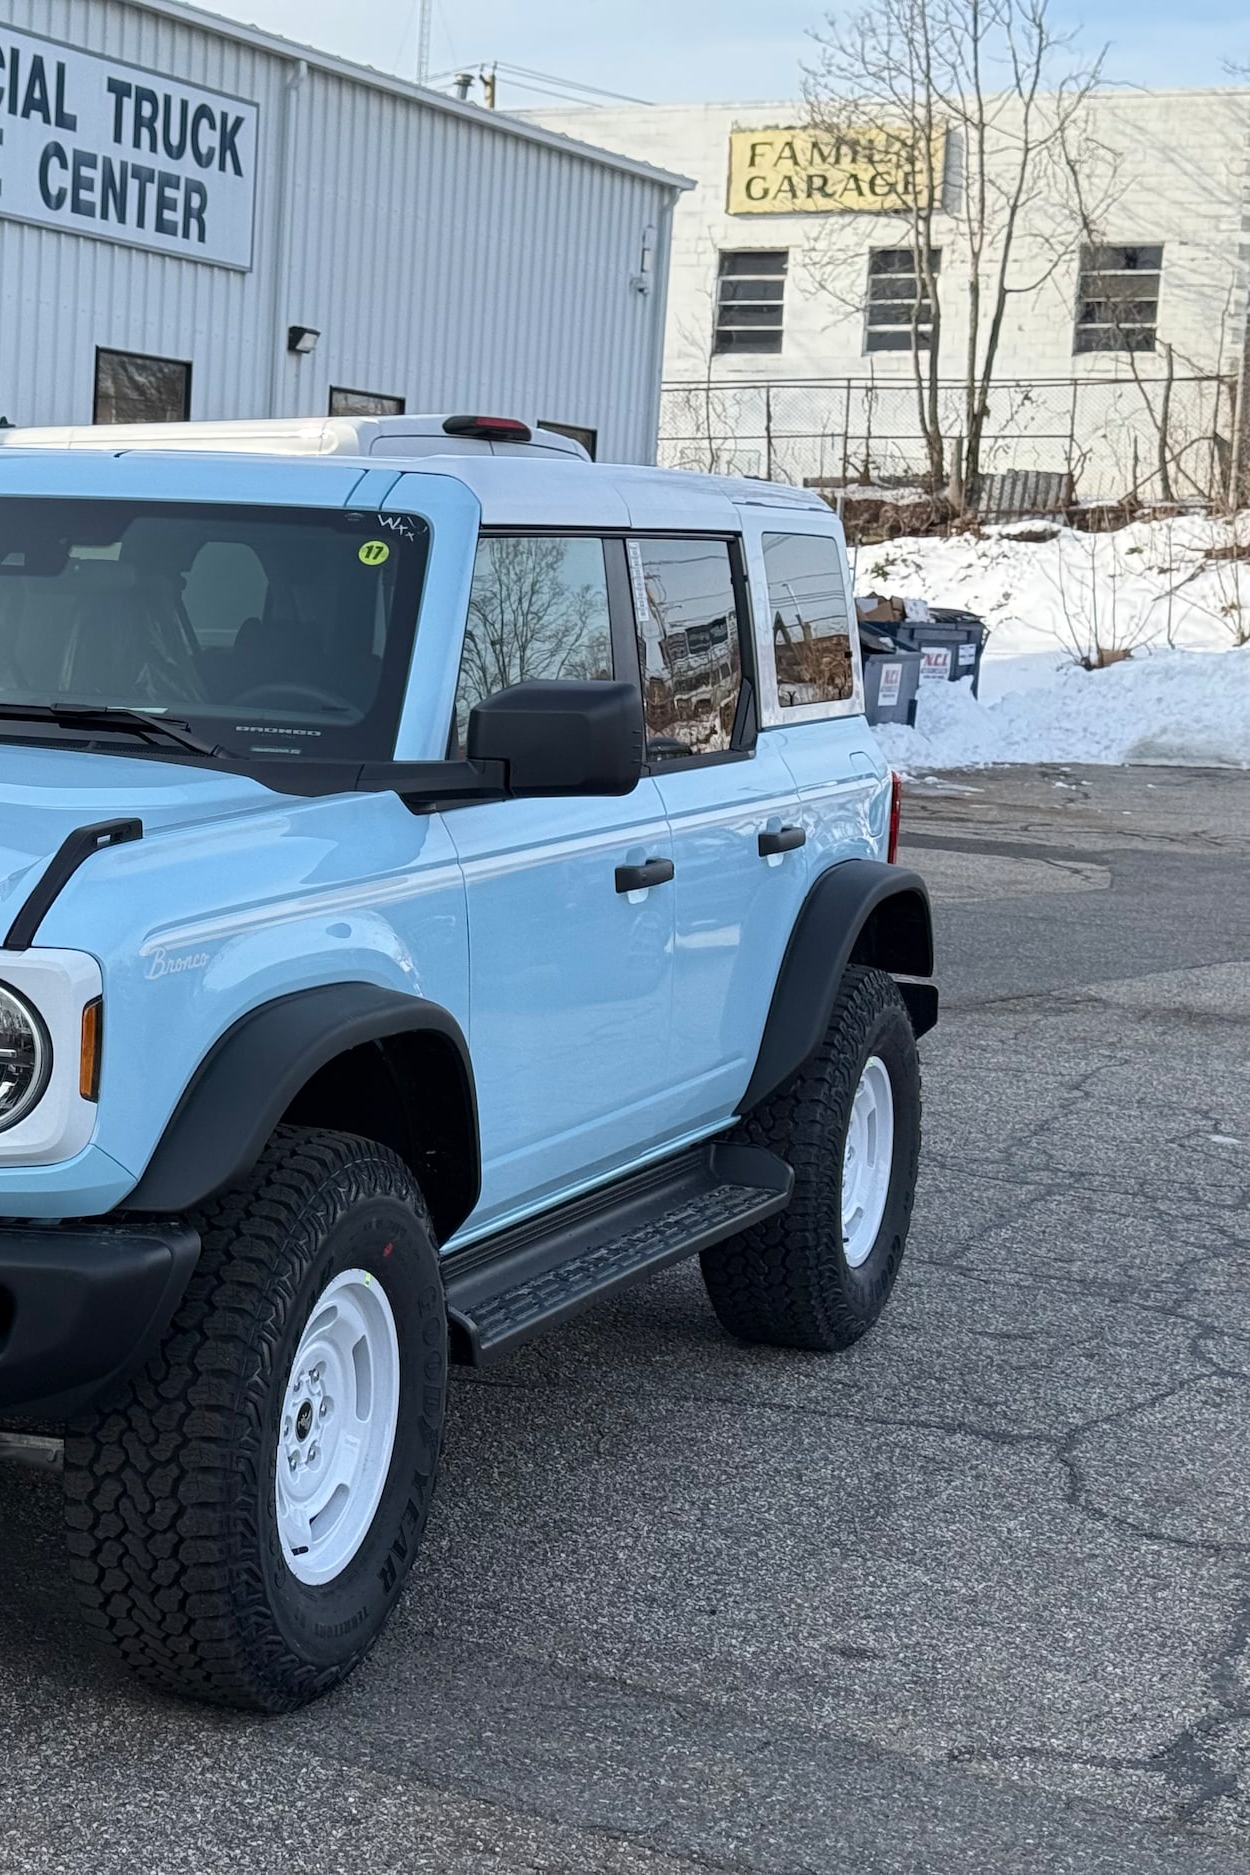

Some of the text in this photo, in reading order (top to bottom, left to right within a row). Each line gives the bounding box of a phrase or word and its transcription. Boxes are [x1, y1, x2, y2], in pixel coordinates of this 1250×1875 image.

[107, 76, 246, 178] TRUCK
[38, 140, 208, 244] CENTER
[745, 171, 924, 201] GARAGE
[364, 544, 384, 560] 17
[235, 725, 322, 736] BRONCO
[144, 946, 210, 980] Bronco
